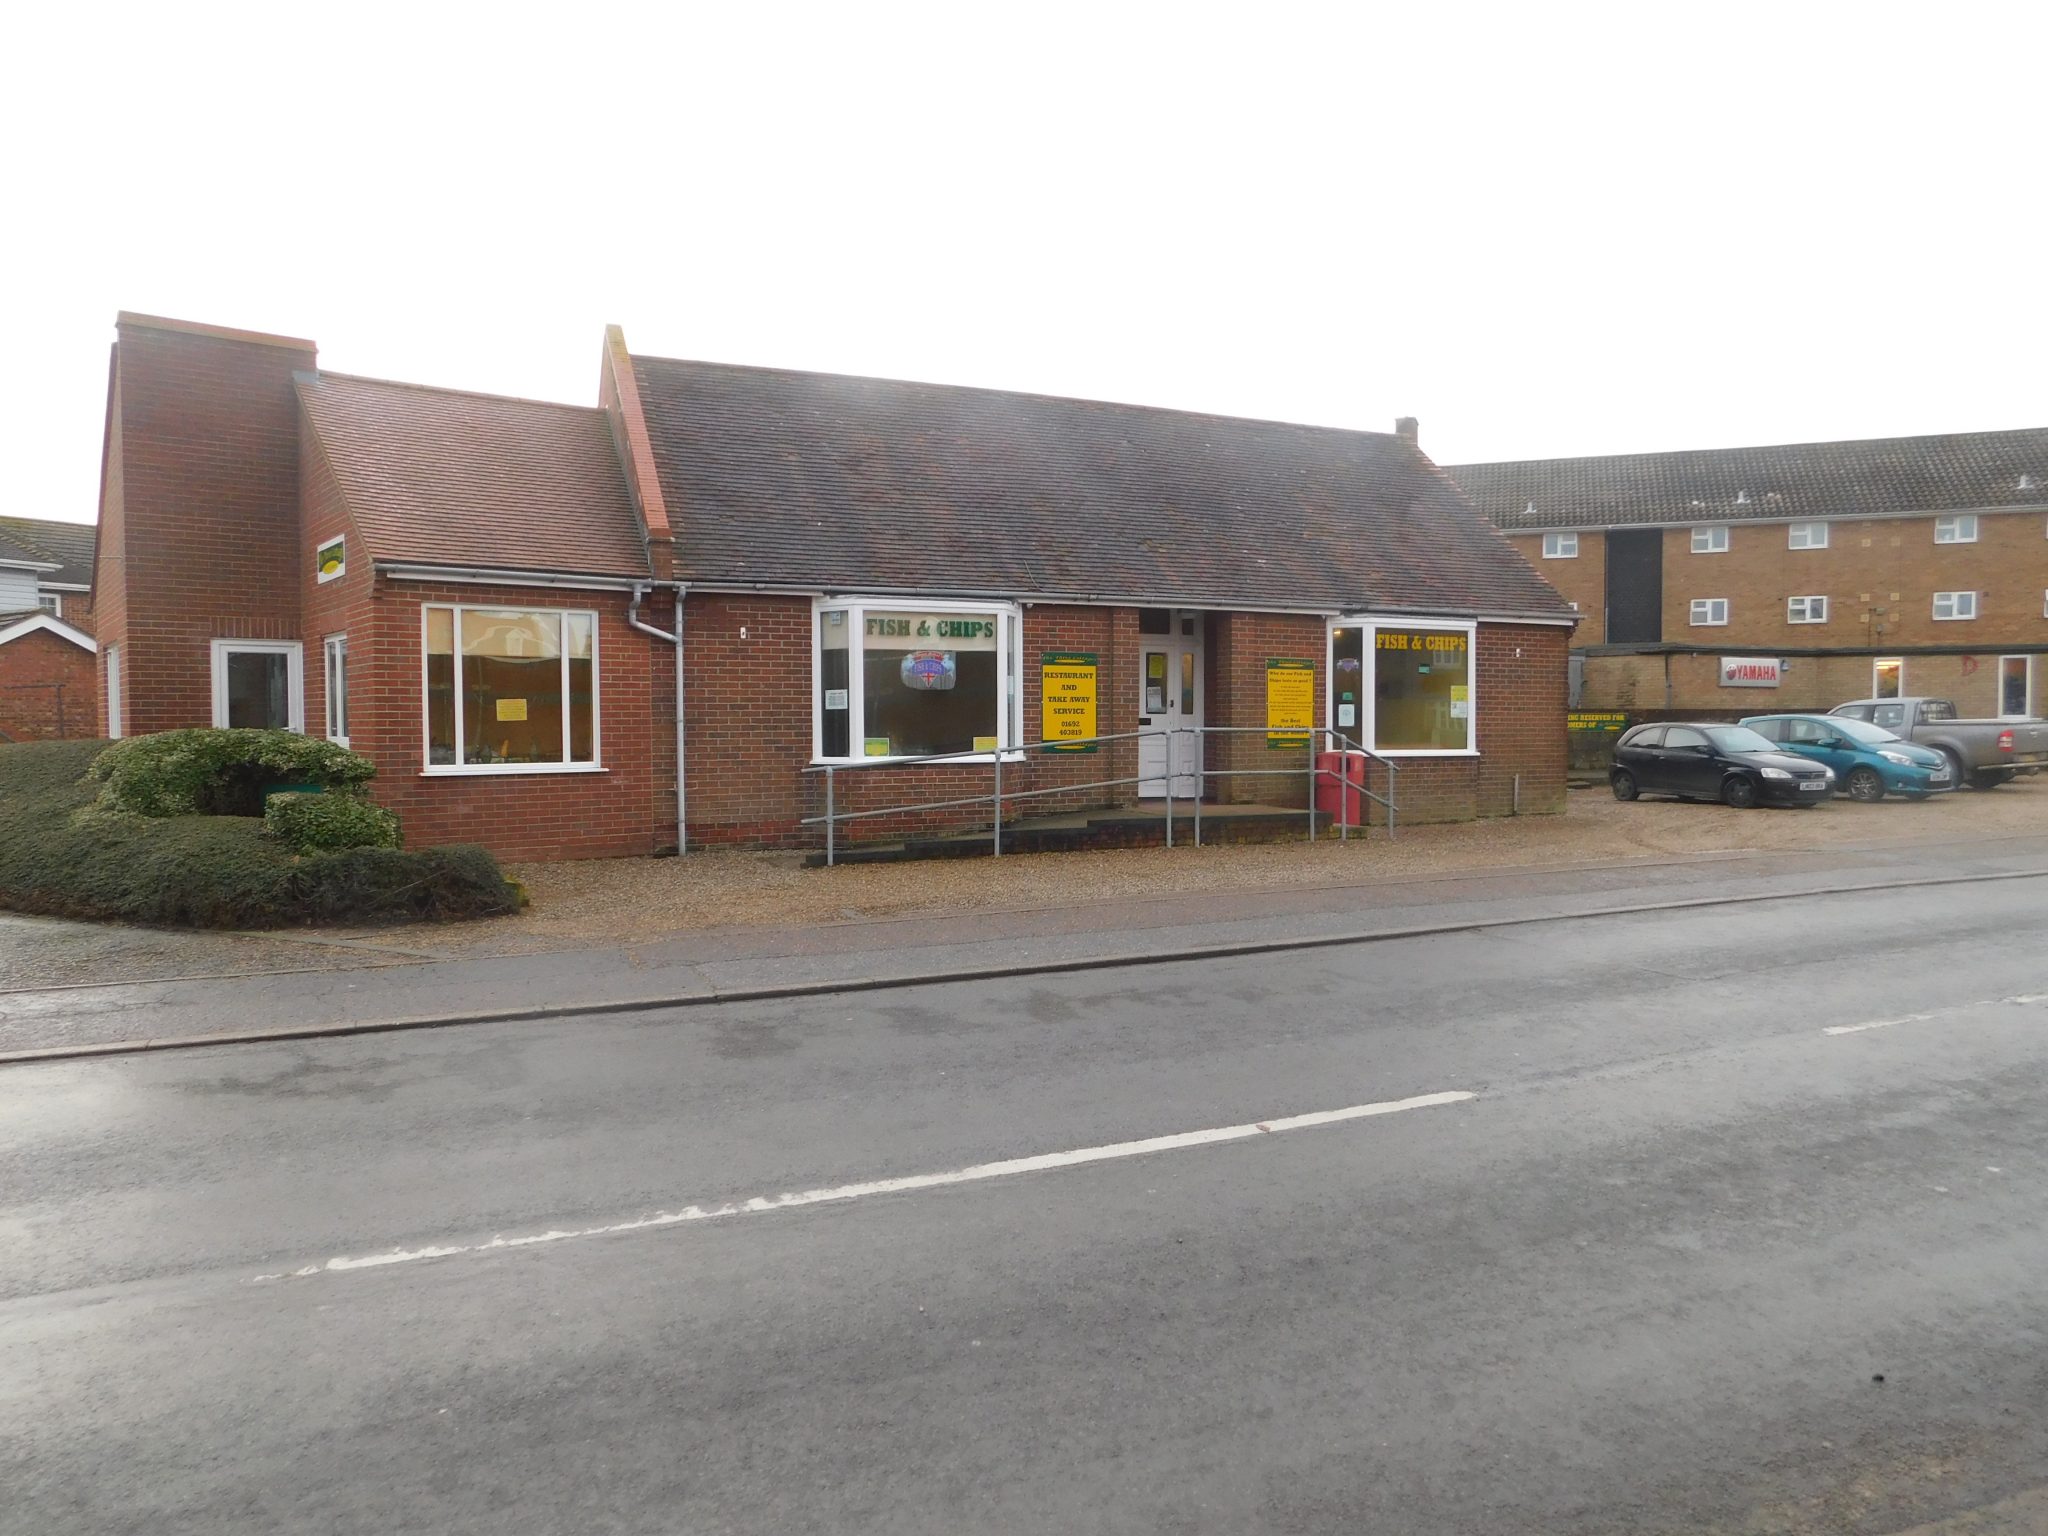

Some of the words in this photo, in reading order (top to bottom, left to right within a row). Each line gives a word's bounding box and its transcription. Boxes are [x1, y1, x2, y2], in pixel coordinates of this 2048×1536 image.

[866, 618, 911, 636] FISH
[916, 620, 931, 637] &
[936, 620, 994, 638] CHIPS
[1376, 634, 1409, 650] FISH
[1411, 635, 1422, 650] &
[1425, 635, 1467, 651] CHIPS
[1736, 665, 1776, 681] YAMAHA
